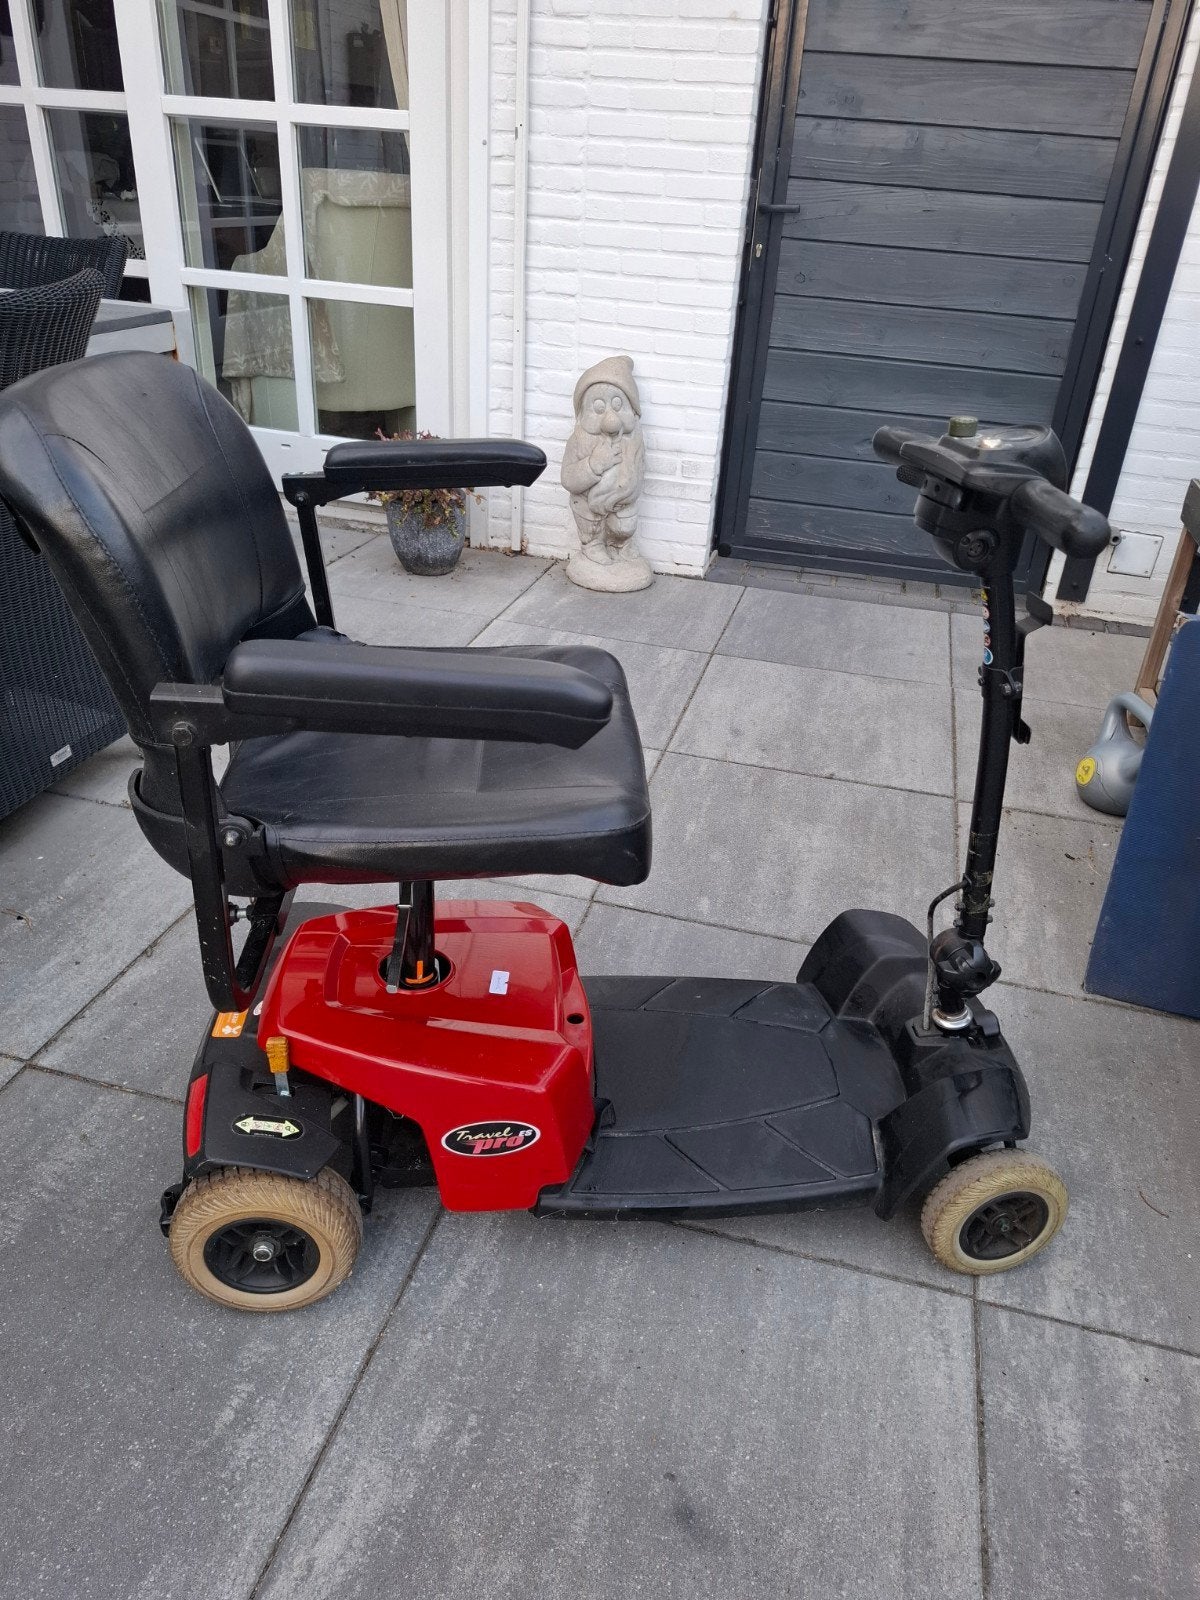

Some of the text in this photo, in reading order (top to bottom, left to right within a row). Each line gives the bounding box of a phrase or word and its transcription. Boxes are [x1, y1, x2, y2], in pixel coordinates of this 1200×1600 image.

[456, 1127, 533, 1142] Travel ES
[470, 1135, 525, 1154] pro
